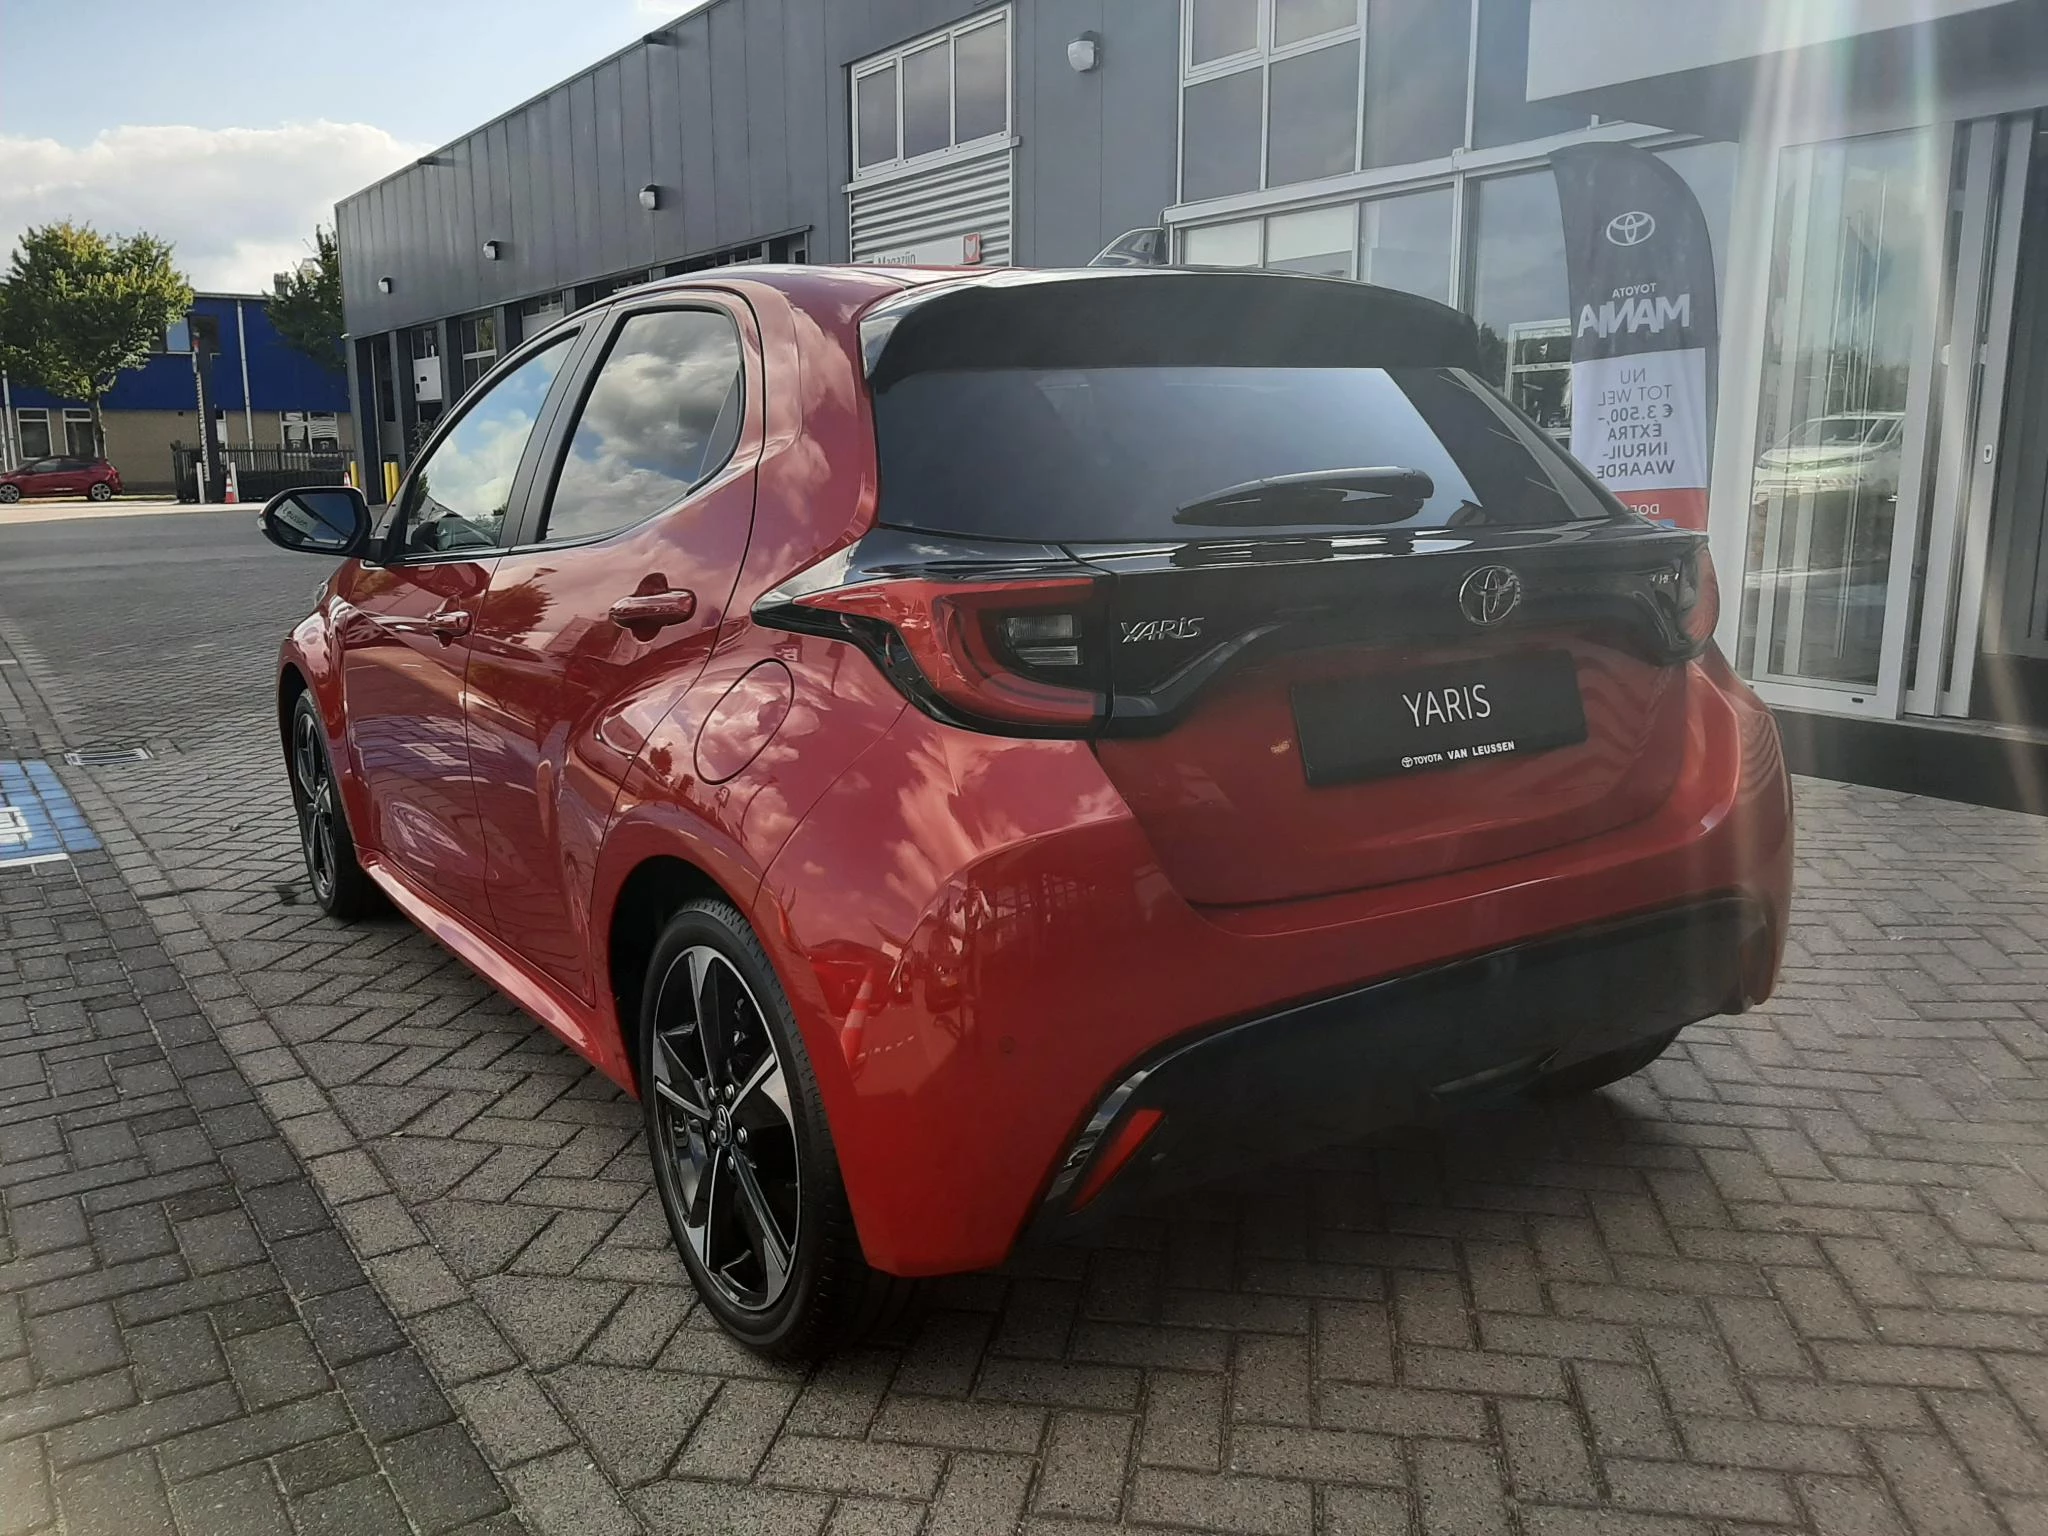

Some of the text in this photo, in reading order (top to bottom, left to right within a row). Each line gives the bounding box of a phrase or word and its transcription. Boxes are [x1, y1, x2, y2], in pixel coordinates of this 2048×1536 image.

[1121, 617, 1204, 643] YARIS
[1402, 684, 1491, 727] YARIS
[1413, 741, 1515, 765] TOYOTA VAN LEUSSEN
